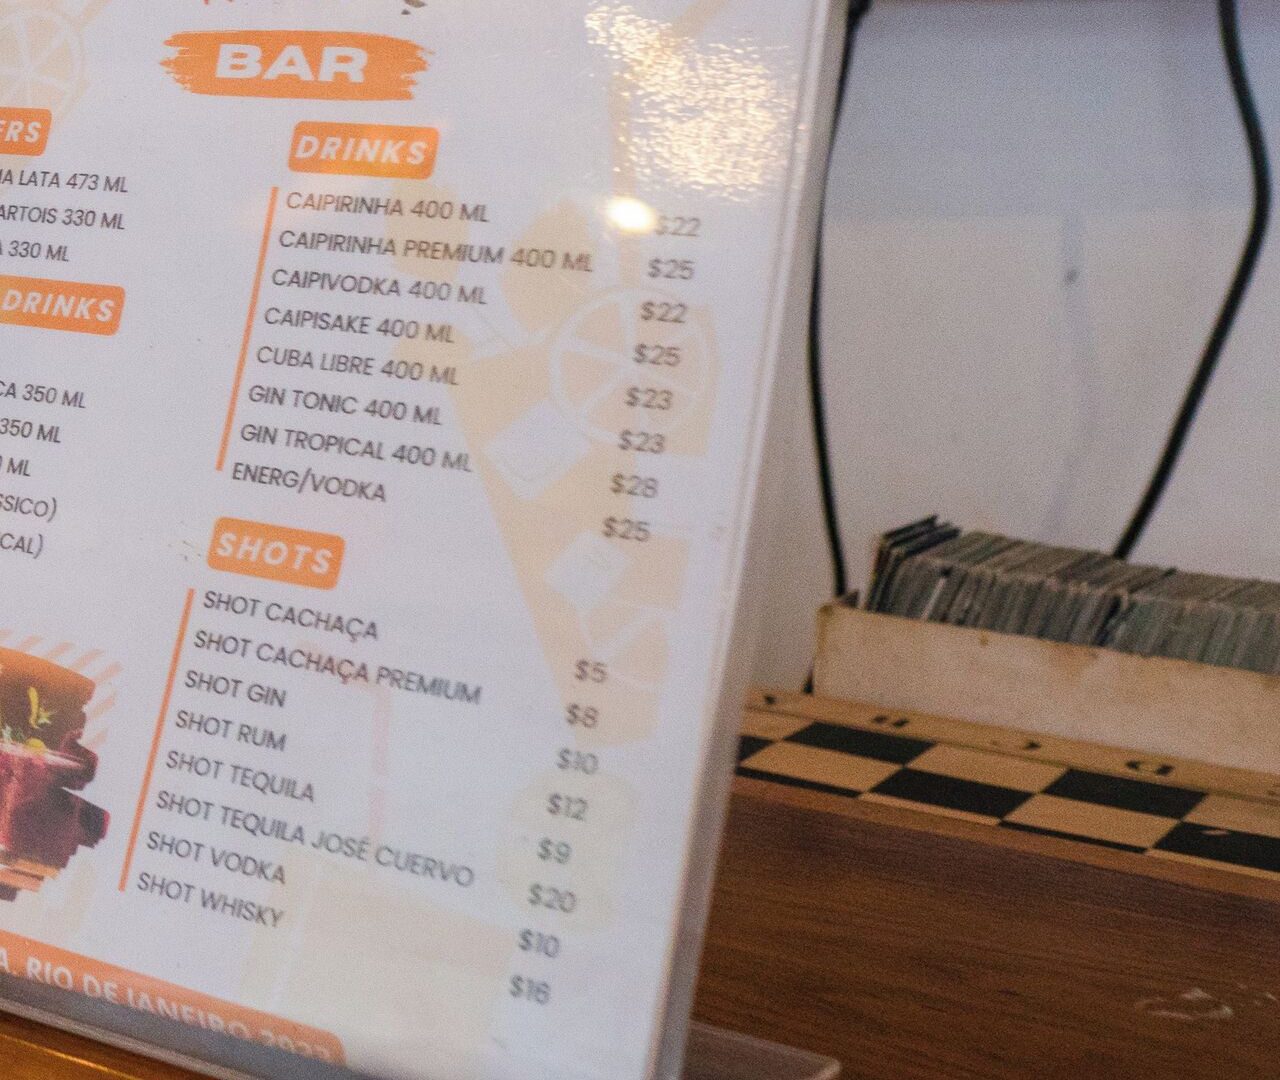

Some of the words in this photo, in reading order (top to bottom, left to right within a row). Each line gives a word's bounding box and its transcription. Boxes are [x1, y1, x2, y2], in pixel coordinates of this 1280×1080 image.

[215, 45, 367, 84] BAR
[295, 135, 426, 166] DRINKS
[19, 170, 60, 188] LATA
[66, 173, 99, 190] 473
[103, 176, 128, 193] ML
[62, 209, 95, 226] 330
[100, 213, 125, 230] ML
[286, 192, 403, 218] CAIPIRINHA
[411, 200, 454, 220] 400
[459, 203, 489, 223] ML
[8, 240, 41, 258] 330
[45, 244, 69, 262] ML
[279, 230, 397, 256] CAIPIRINHA
[403, 238, 504, 265] PREMIUM
[511, 249, 555, 269] 400
[562, 250, 593, 272] ML
[648, 258, 694, 281] $25
[272, 269, 400, 297] CAIPIVODKA
[408, 281, 450, 302] 400
[458, 285, 487, 305] ML
[2, 290, 116, 322] DRINKS
[641, 301, 686, 324] $22
[264, 307, 371, 336] CAIPISAKE
[377, 318, 419, 339] 400
[425, 324, 455, 344] ML
[256, 346, 313, 370] CUBA
[320, 353, 373, 376] LIBRE
[380, 360, 423, 381] 400
[430, 365, 459, 386] ML
[634, 344, 681, 367] $25
[22, 384, 56, 404] 350
[62, 390, 86, 408] ML
[249, 385, 286, 406] GIN
[293, 391, 357, 415] TONIC
[364, 399, 407, 420] 400
[414, 405, 443, 426] ML
[624, 387, 672, 411] $23
[36, 424, 62, 444] ML
[241, 424, 277, 445] GIN
[284, 430, 385, 461] TROPICAL
[392, 444, 436, 466] 400
[442, 452, 472, 473] ML
[618, 430, 665, 455] $23
[6, 457, 32, 476] ML
[232, 462, 387, 502] ENERG/VODKA
[602, 517, 649, 542] $25
[215, 532, 333, 574] SHOTS
[203, 590, 262, 618] SHOT
[265, 602, 379, 644] CACHAÇA
[194, 630, 252, 657] SHOT
[256, 643, 369, 685] CACHAÇA
[375, 666, 482, 705] PREMIUM
[574, 658, 607, 684] $5
[185, 670, 243, 698] SHOT
[247, 684, 287, 709] GIN
[175, 709, 233, 739] SHOT
[237, 724, 287, 753] RUM
[565, 702, 598, 729] $8
[165, 750, 225, 779] SHOT
[230, 764, 316, 803] TEQUILA
[557, 747, 598, 776] $10
[546, 792, 588, 821] $12
[156, 790, 214, 820] SHOT
[221, 805, 306, 844] TEQUILA
[311, 830, 369, 863] JOSÉ
[375, 845, 475, 889] CUERVO
[538, 837, 572, 865] $9
[146, 831, 204, 861] SHOT
[210, 846, 287, 885] VODKA
[137, 872, 196, 902] SHOT
[200, 888, 284, 930] WHISKY
[528, 882, 577, 913] $20
[518, 927, 560, 959] $10
[26, 955, 74, 991] RIO
[82, 972, 118, 1005] DE
[508, 973, 551, 1006] $16
